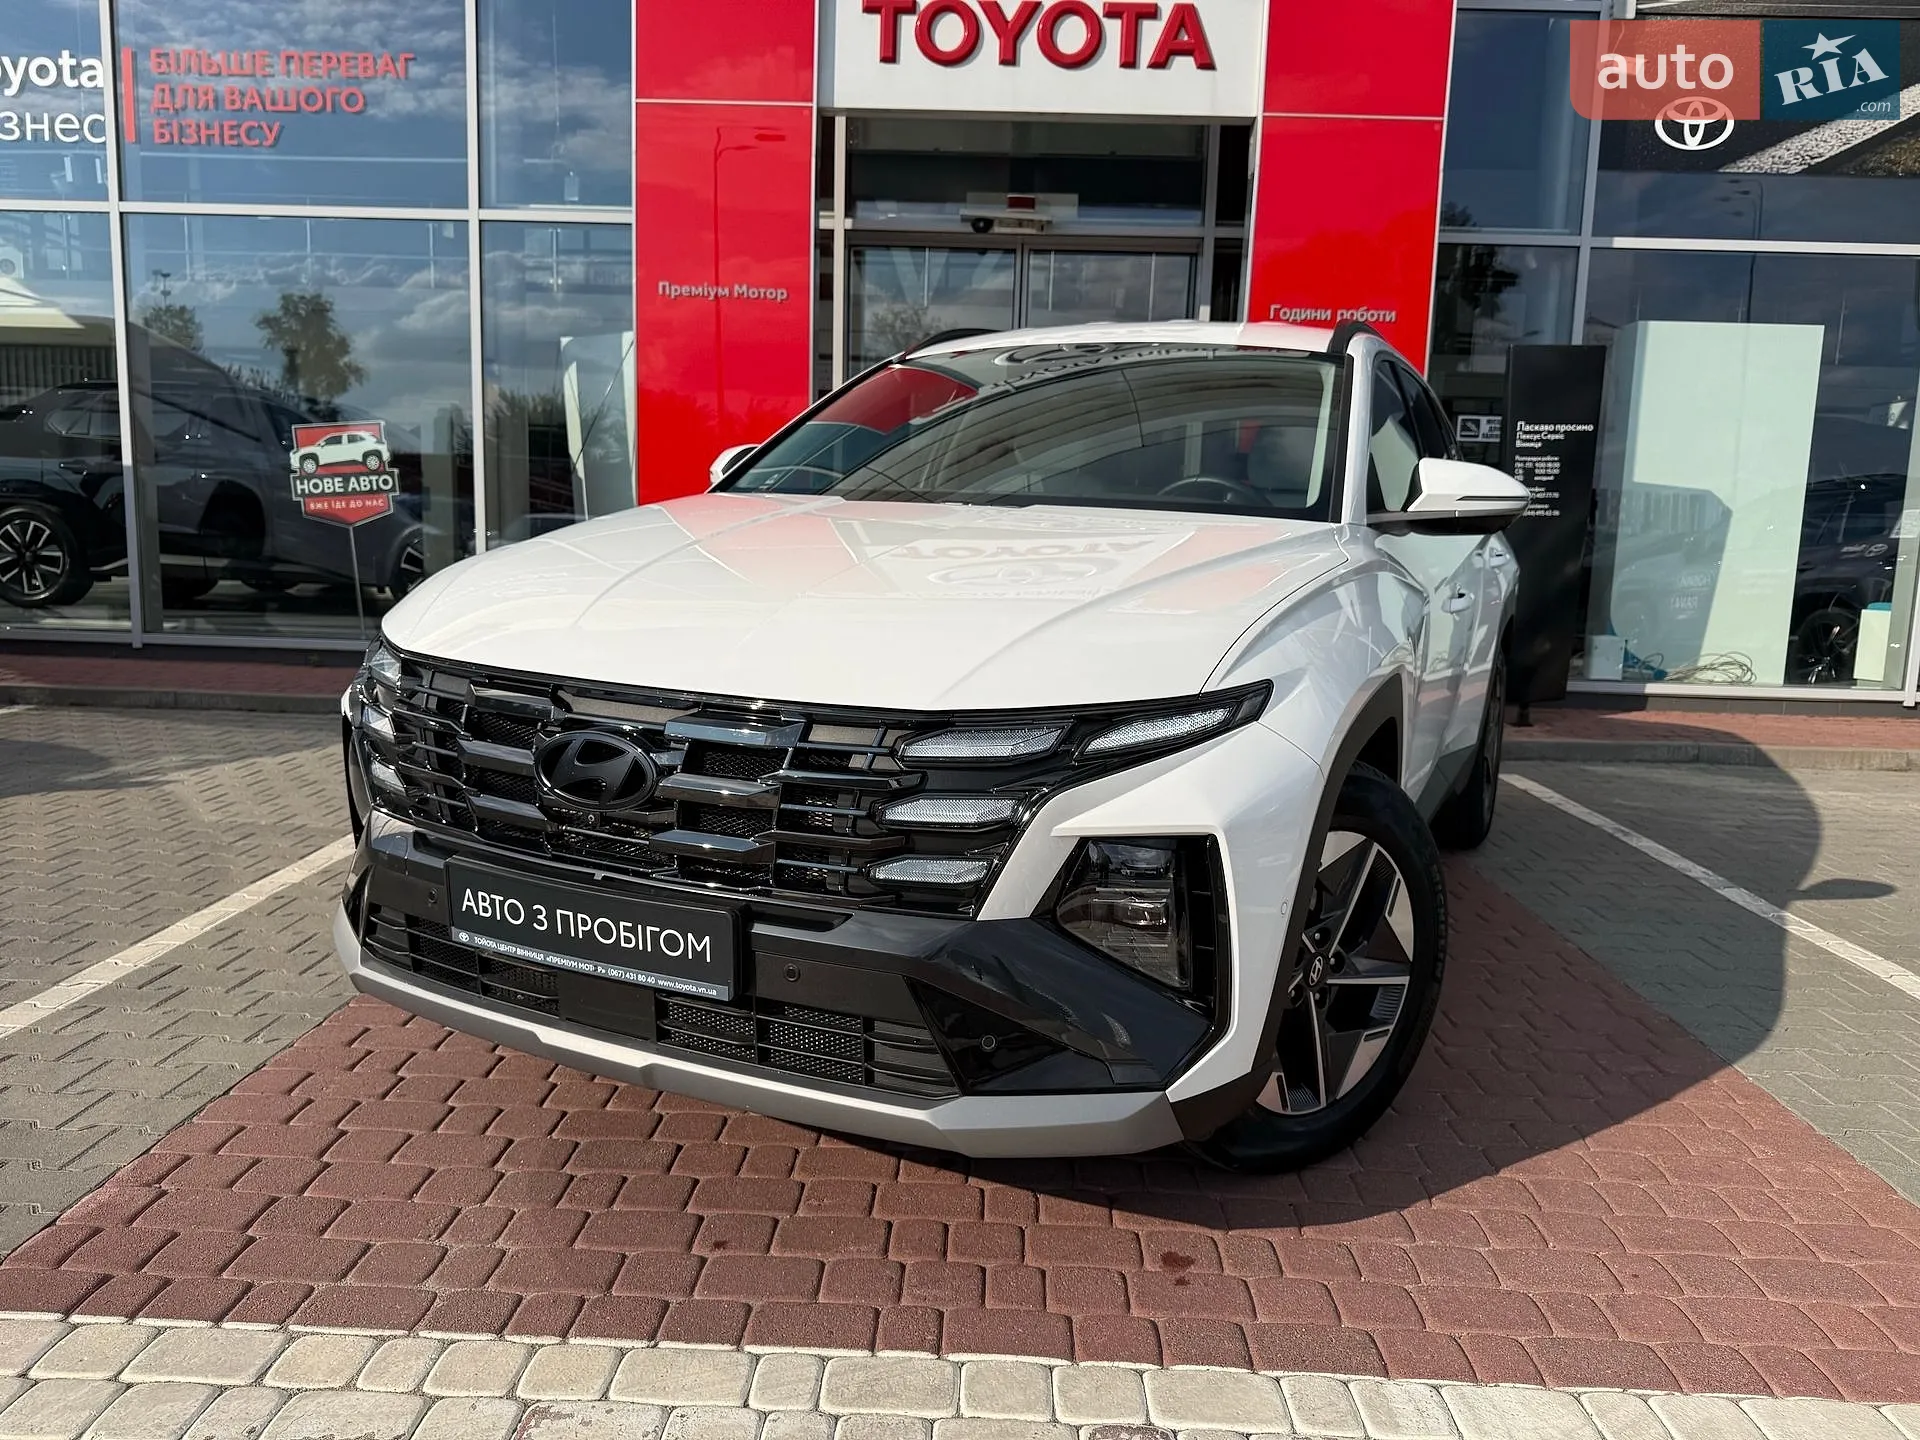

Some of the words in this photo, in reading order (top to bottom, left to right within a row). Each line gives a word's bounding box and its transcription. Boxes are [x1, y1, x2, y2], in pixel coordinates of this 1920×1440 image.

[862, 0, 1217, 70] TOYOTA
[0, 50, 104, 96] yota
[149, 48, 274, 77] БІЛЬШЕ
[280, 51, 414, 79] ПЕРЕВАГ
[150, 84, 214, 113] ДЛЯ
[222, 86, 366, 113] ВАШОГО
[153, 120, 281, 147] БІЗНЕСУ
[658, 281, 729, 299] Преміум
[734, 283, 788, 302] Мотор
[1269, 304, 1331, 322] Години
[296, 476, 344, 494] НОВЕ
[348, 474, 393, 492] АВТО
[462, 888, 525, 926] АВТО
[556, 909, 711, 963] ПРОБІГОМ
[497, 943, 516, 953] ЦЕНТР
[516, 946, 544, 961] ВІННИЦЯ
[607, 970, 625, 979] (067)
[625, 972, 637, 981] 431
[637, 973, 646, 983] 80
[646, 975, 656, 984] 40
